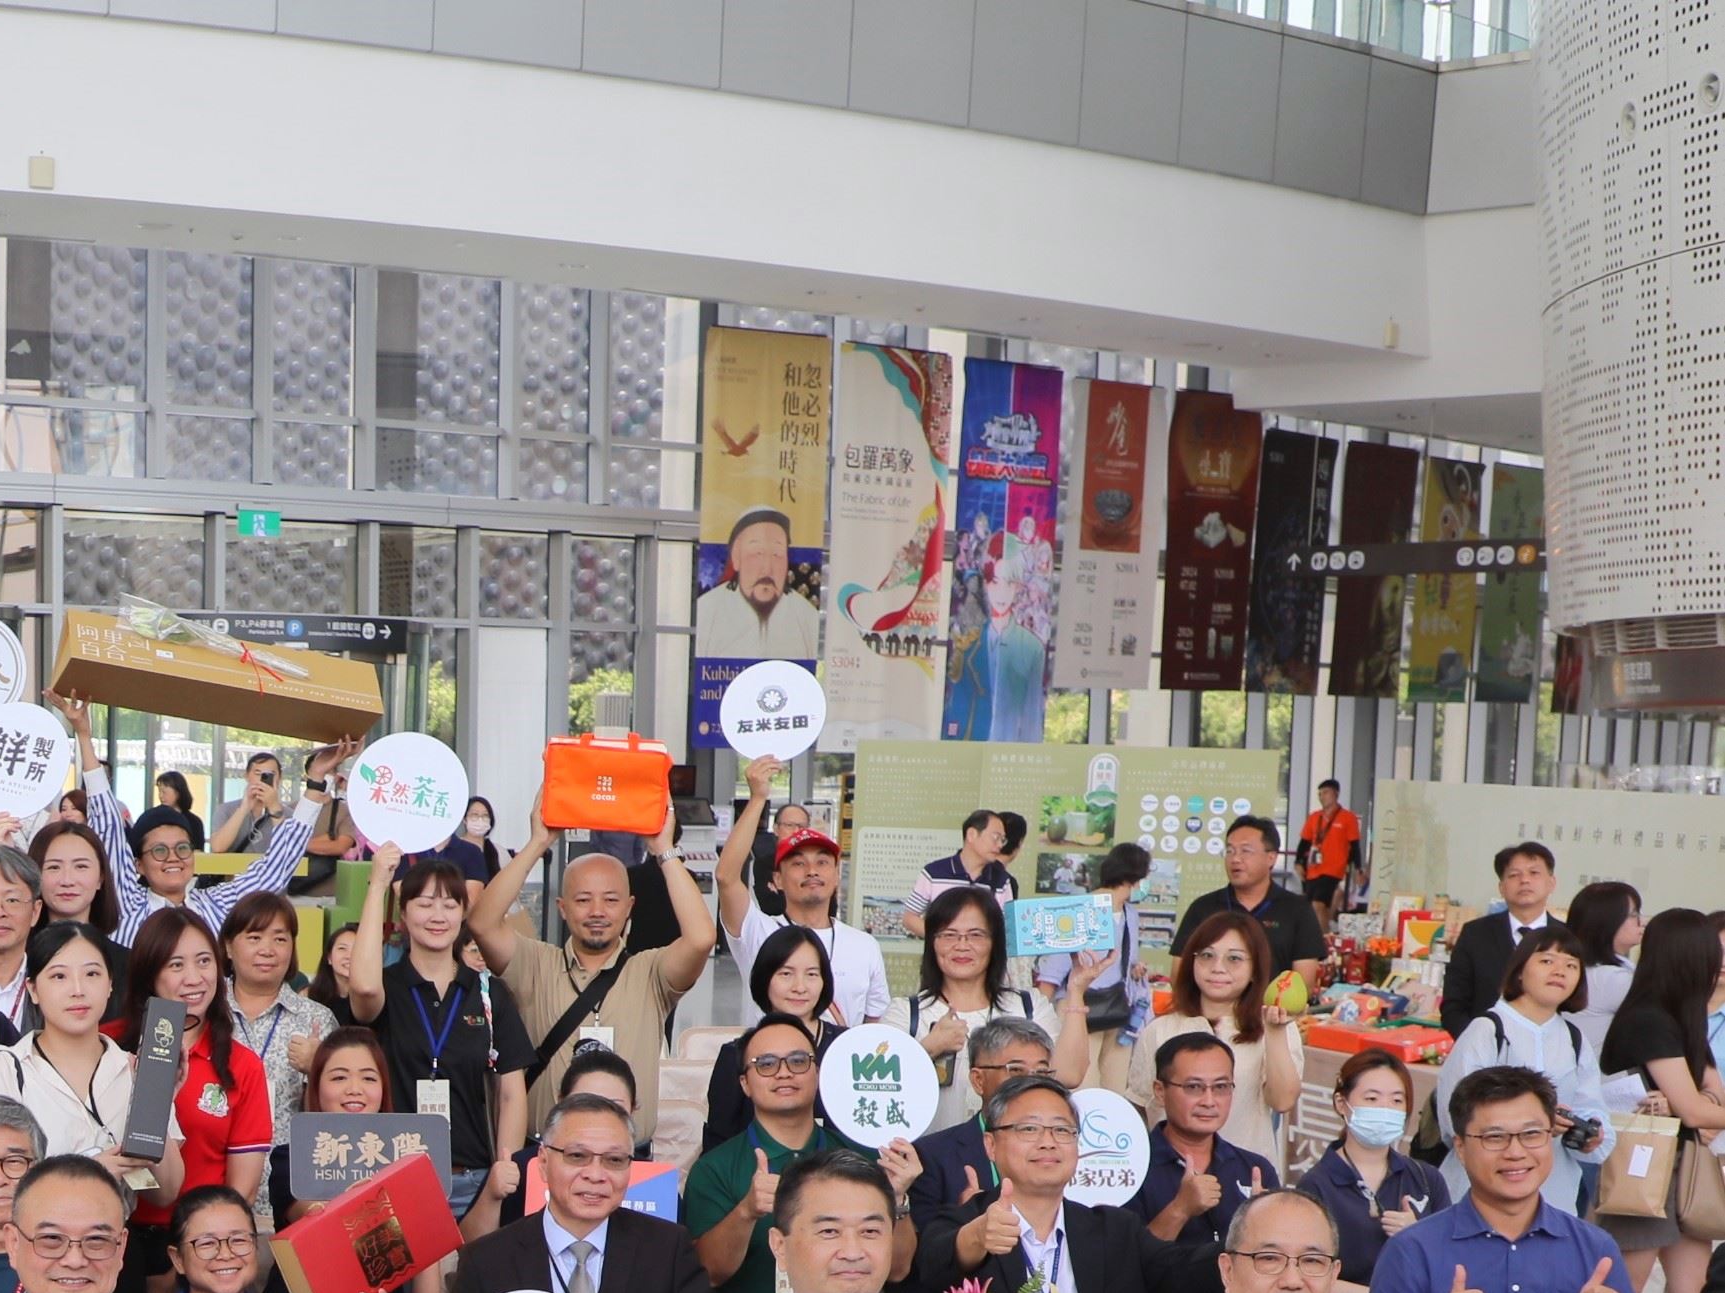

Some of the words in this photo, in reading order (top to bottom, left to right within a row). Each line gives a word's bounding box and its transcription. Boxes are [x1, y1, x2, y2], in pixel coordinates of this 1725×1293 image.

[802, 362, 822, 447] 忽必烈
[779, 361, 802, 504] 和他的時代
[845, 443, 915, 474] 包羅萬象
[700, 685, 722, 700] and
[312, 1131, 429, 1168] 新東陽
[315, 1169, 347, 1181] HSIN
